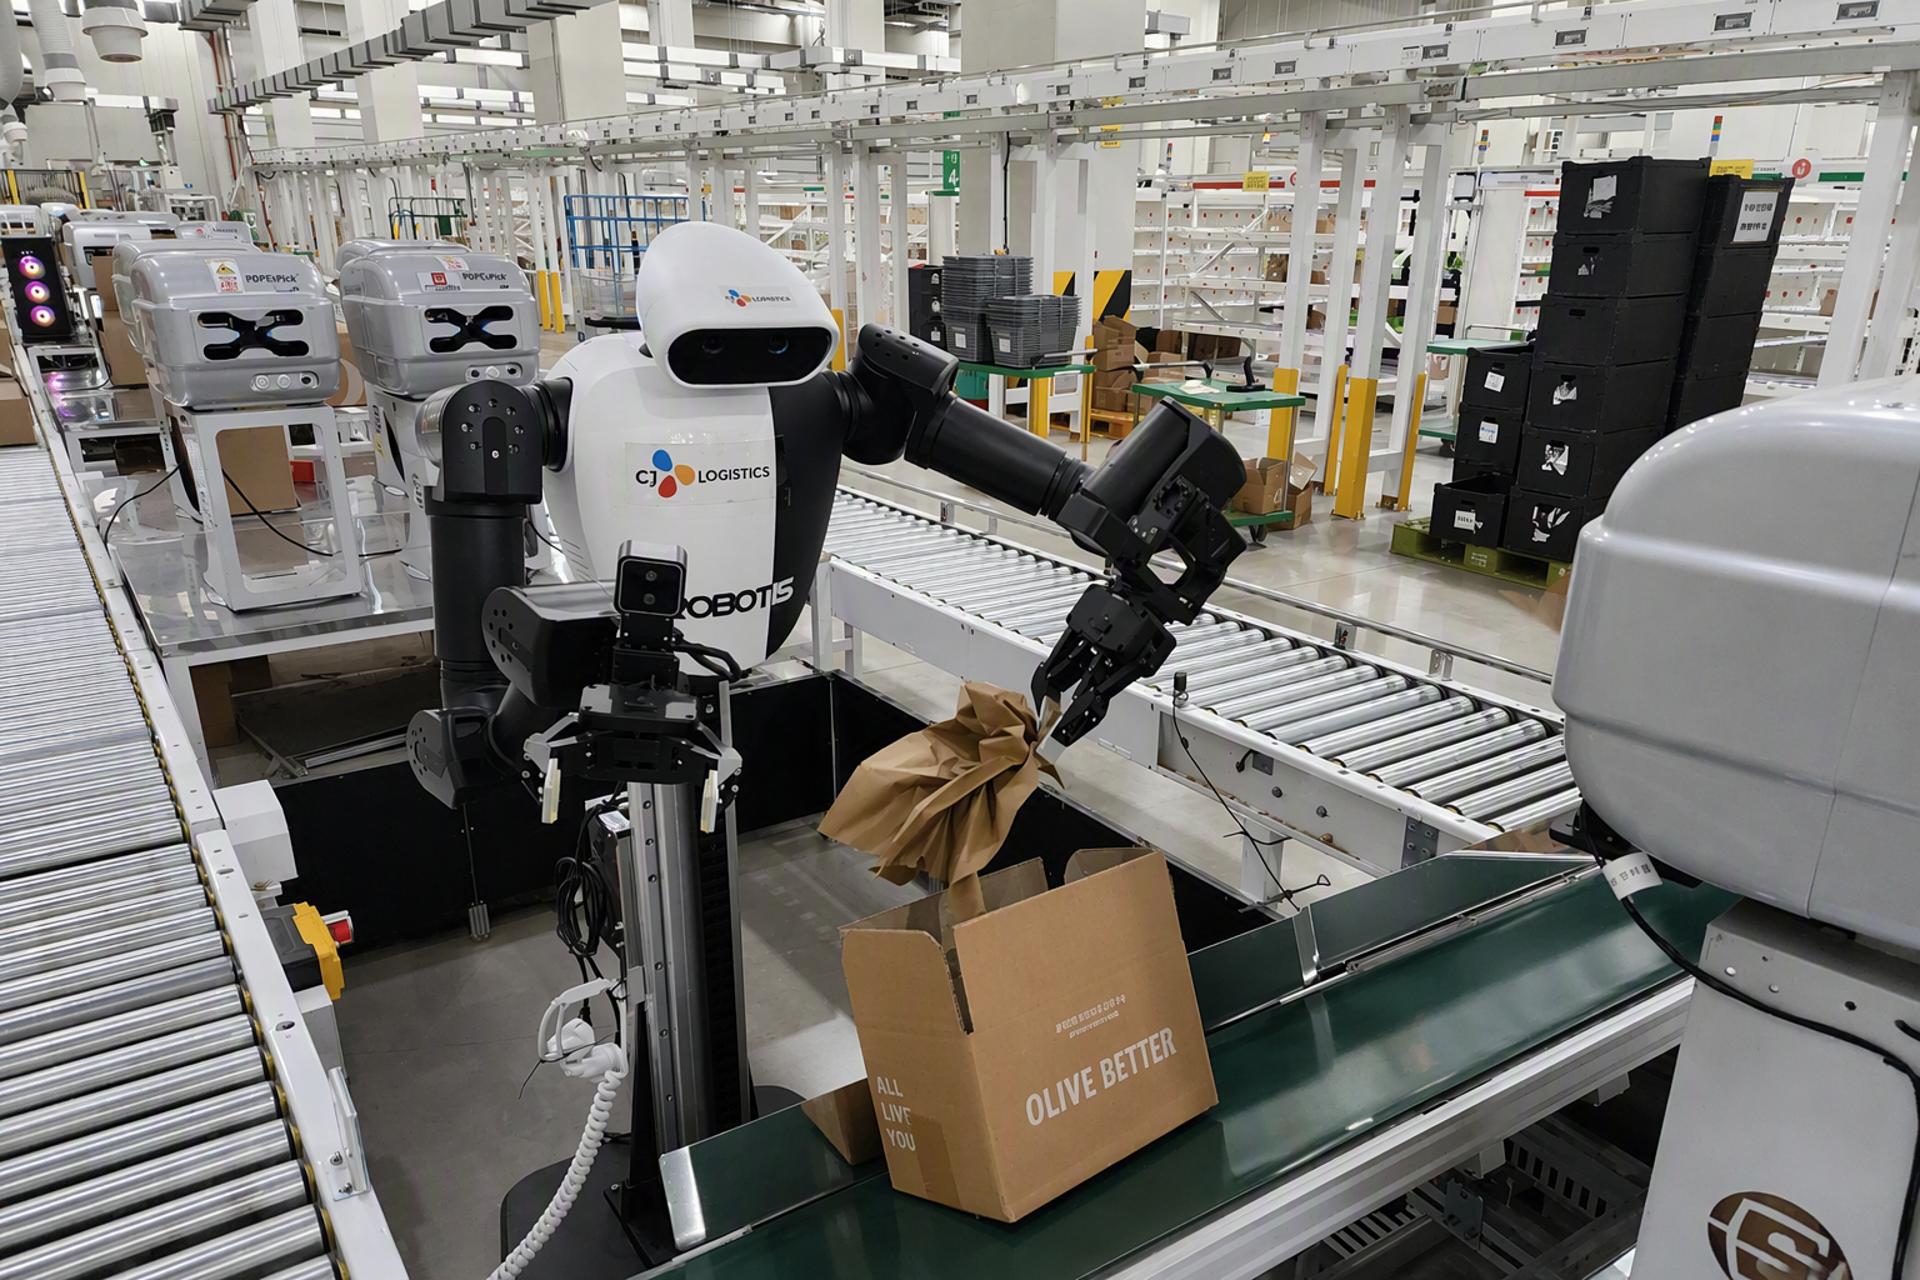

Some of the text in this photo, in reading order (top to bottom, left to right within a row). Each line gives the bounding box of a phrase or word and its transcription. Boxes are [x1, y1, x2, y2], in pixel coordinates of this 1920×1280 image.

[635, 466, 770, 487] CJ LOGISTICS
[877, 1076, 904, 1097] ALL
[1025, 1027, 1177, 1126] OLIVE BETTER
[881, 1102, 912, 1126] LIVE
[886, 1128, 916, 1152] YOU
